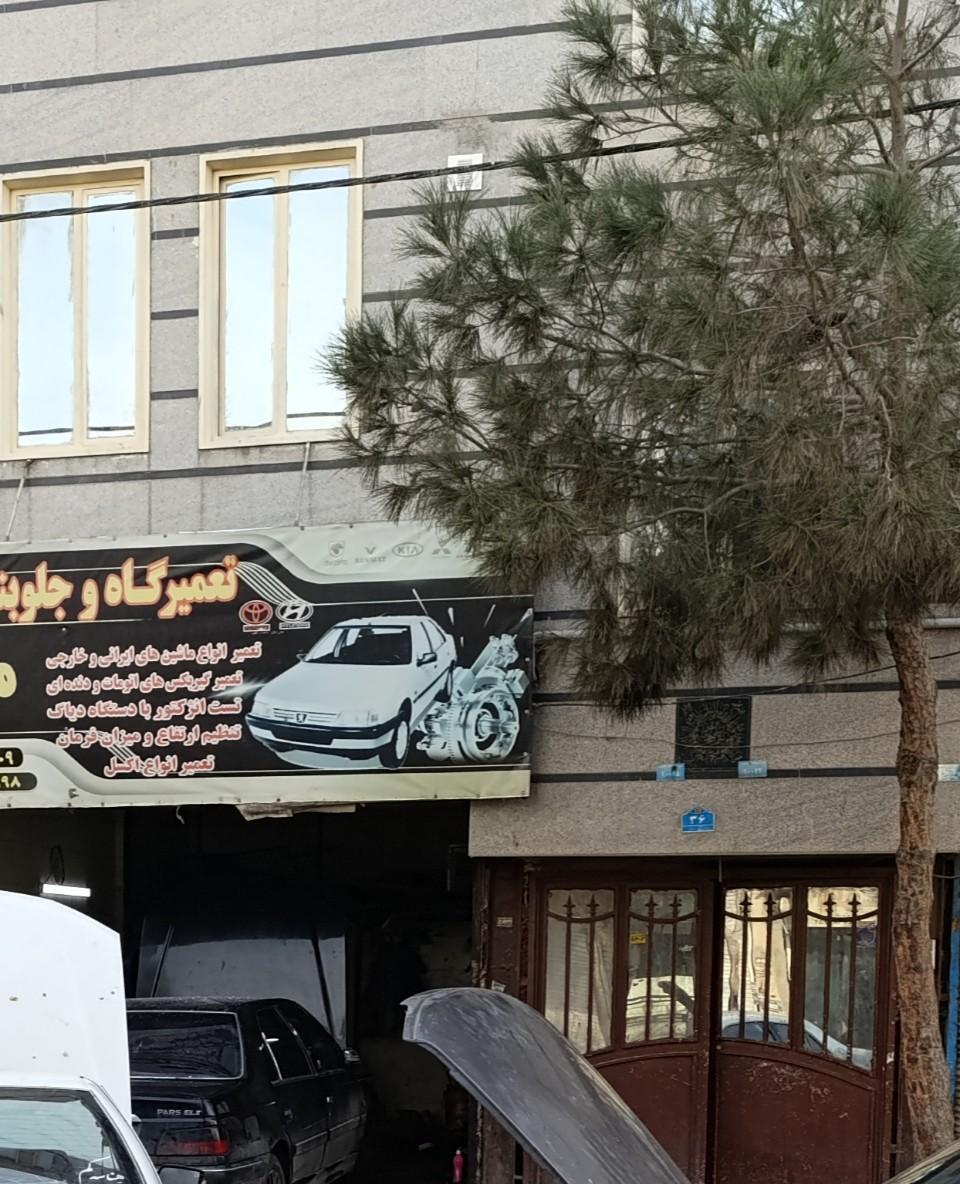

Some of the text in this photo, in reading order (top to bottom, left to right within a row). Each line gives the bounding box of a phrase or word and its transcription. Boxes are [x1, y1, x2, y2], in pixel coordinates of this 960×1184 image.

[104, 554, 238, 619] تعمیرگاه
[77, 578, 99, 621] و
[46, 641, 262, 669] تعمیر انواع ماشین های ایرانی و خارجی
[92, 679, 100, 695] و
[101, 672, 139, 694] اتومات
[140, 671, 164, 692] های
[212, 670, 243, 691] تعمیر
[139, 699, 151, 720] با
[207, 697, 243, 714] تست
[56, 723, 242, 748] تنظیم ارتفاع و میزان فرمان
[143, 755, 177, 775] انواع
[180, 755, 215, 775] تعمیر
[157, 1108, 182, 1116] PARS
